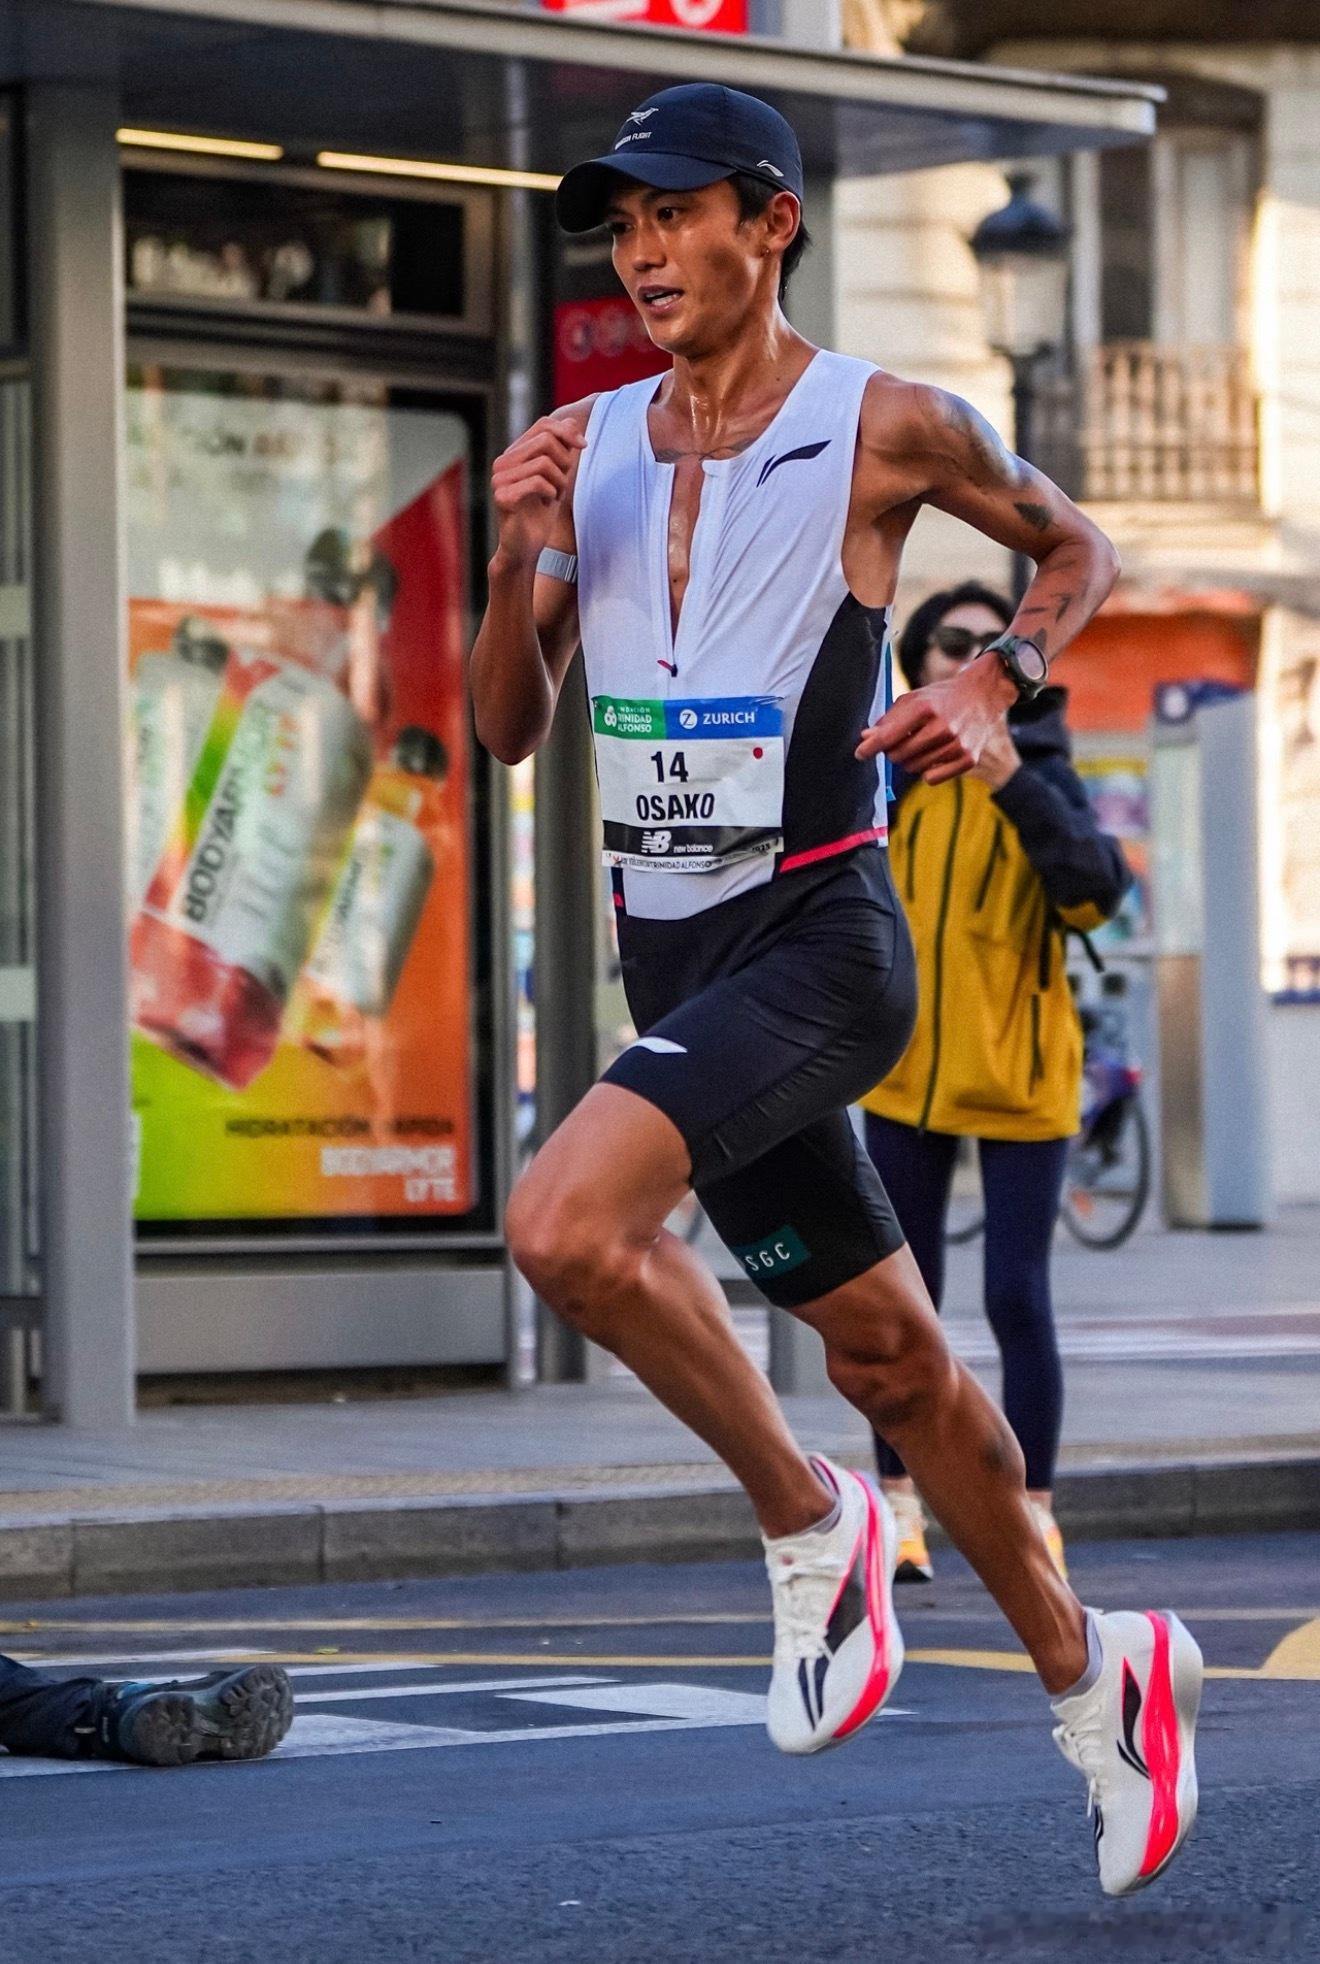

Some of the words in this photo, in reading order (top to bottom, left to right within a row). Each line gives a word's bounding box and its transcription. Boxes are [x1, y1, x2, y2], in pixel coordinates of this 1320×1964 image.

[702, 711, 756, 726] ZURICH
[650, 750, 690, 784] 14
[635, 792, 716, 822] OSAKO
